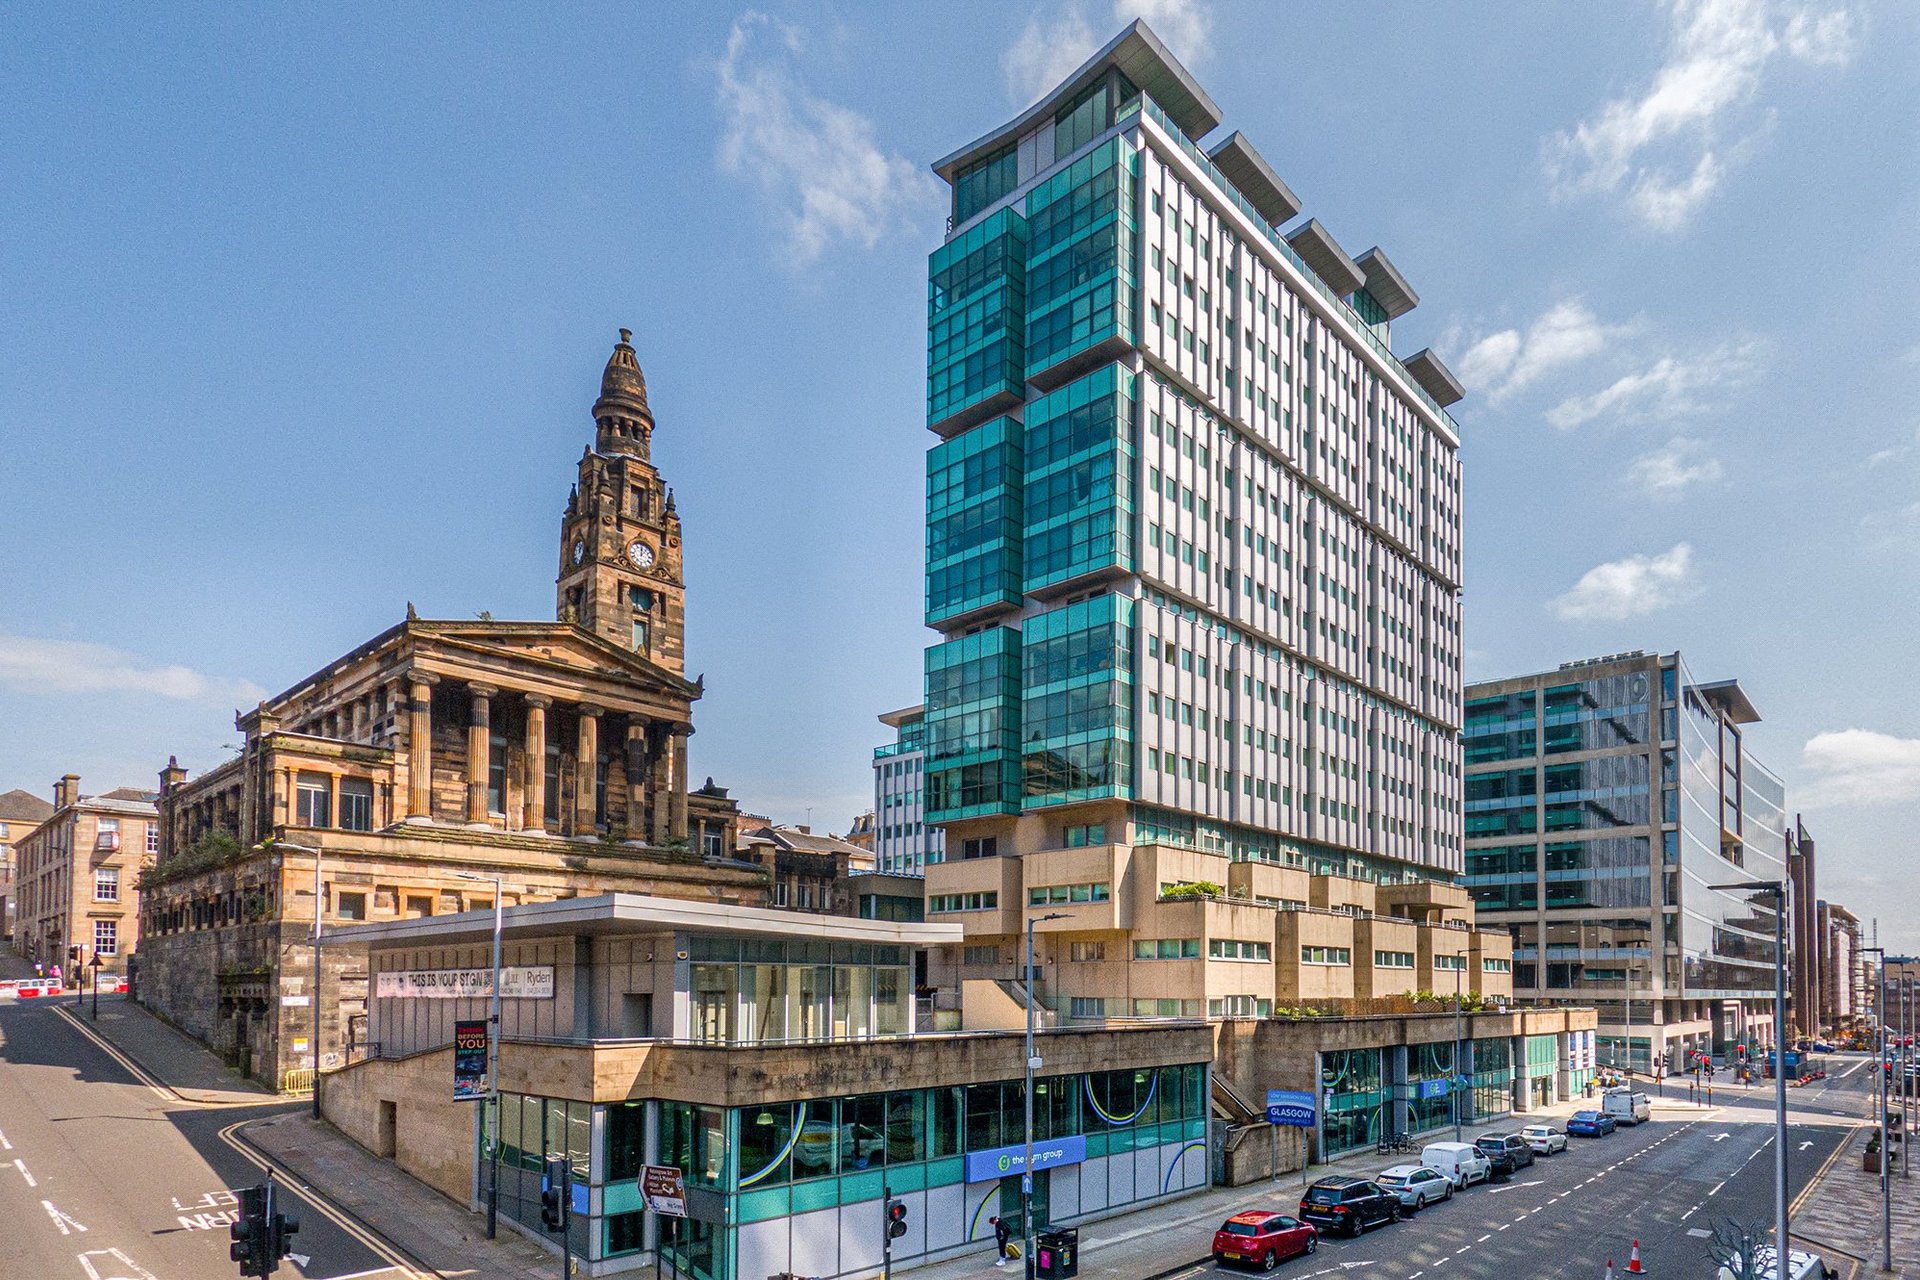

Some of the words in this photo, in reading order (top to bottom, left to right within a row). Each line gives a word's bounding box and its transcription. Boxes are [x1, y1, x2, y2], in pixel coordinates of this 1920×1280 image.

[408, 974, 426, 987] THIS
[427, 974, 436, 987] IS
[460, 972, 482, 986] SIGN
[527, 971, 550, 986] Ryden
[458, 1039, 486, 1049] YOU
[1270, 1107, 1312, 1118] GLASGOW
[1012, 1155, 1025, 1165] the
[1042, 1149, 1063, 1162] group
